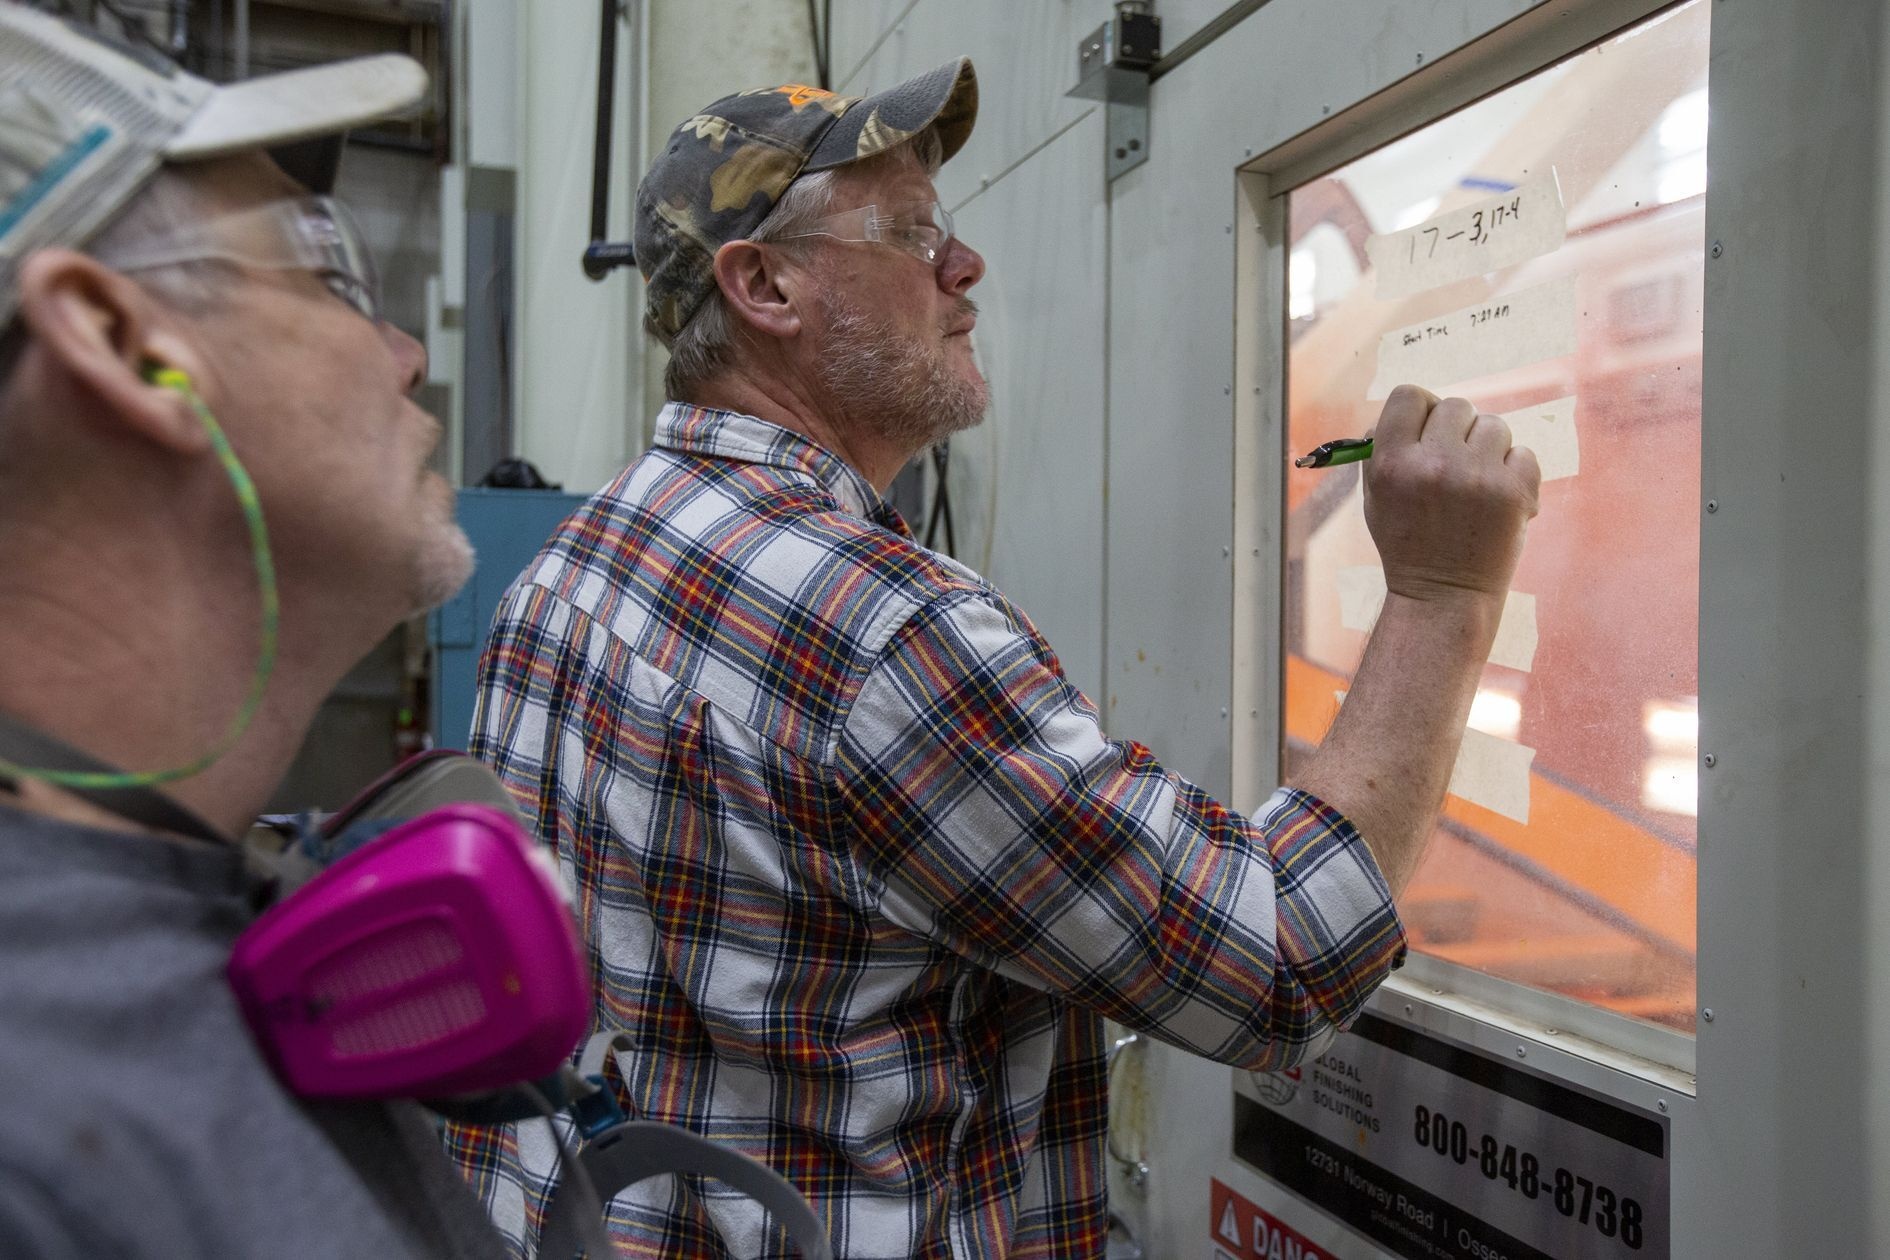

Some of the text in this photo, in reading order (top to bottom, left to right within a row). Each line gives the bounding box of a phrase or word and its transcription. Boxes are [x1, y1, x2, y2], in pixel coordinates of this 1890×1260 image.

[1312, 1070, 1373, 1108] FINISHING
[1312, 1089, 1381, 1133] SOLUTIONS
[1304, 1145, 1340, 1178] 12731
[1344, 1165, 1394, 1210] Norway
[1397, 1194, 1434, 1231] Road
[1414, 1104, 1643, 1250] 800-848-8738
[1253, 1215, 1320, 1260] DAN
